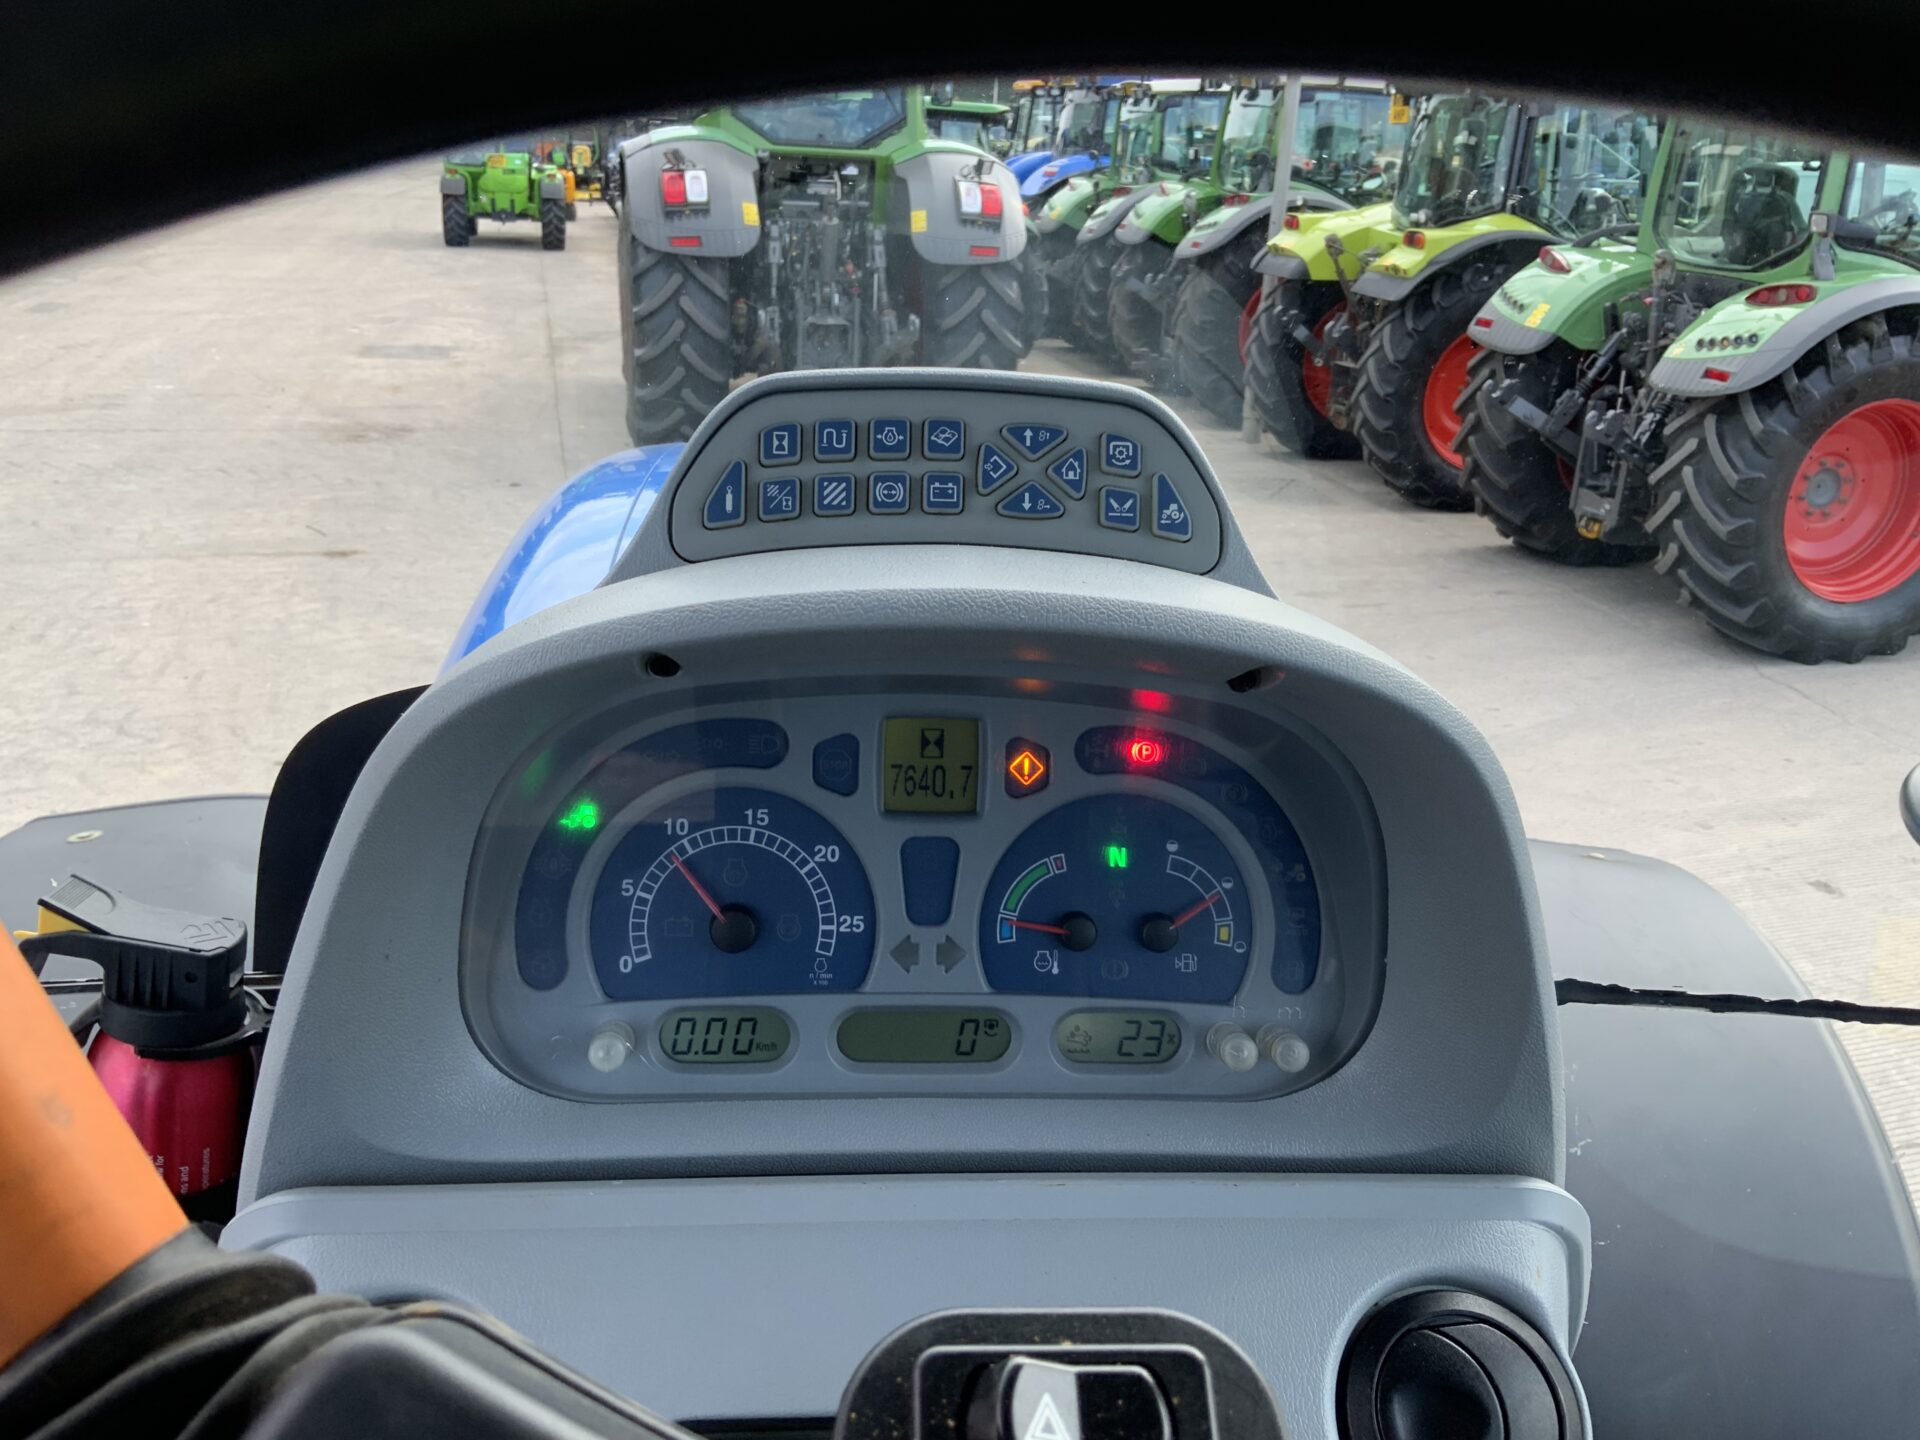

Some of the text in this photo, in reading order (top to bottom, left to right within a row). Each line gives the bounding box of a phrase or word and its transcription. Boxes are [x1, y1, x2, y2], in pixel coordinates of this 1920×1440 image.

[891, 764, 973, 799] 7640.7
[744, 808, 770, 826] 15
[663, 818, 690, 836] 10
[813, 845, 840, 863] 20
[1108, 846, 1127, 868] N
[620, 879, 635, 897] 5
[838, 915, 866, 934] 25
[618, 956, 633, 974] 0
[671, 1017, 758, 1056] 0.00
[955, 1018, 981, 1056] 0
[1116, 1019, 1167, 1058] 23
[179, 1165, 190, 1183] and
